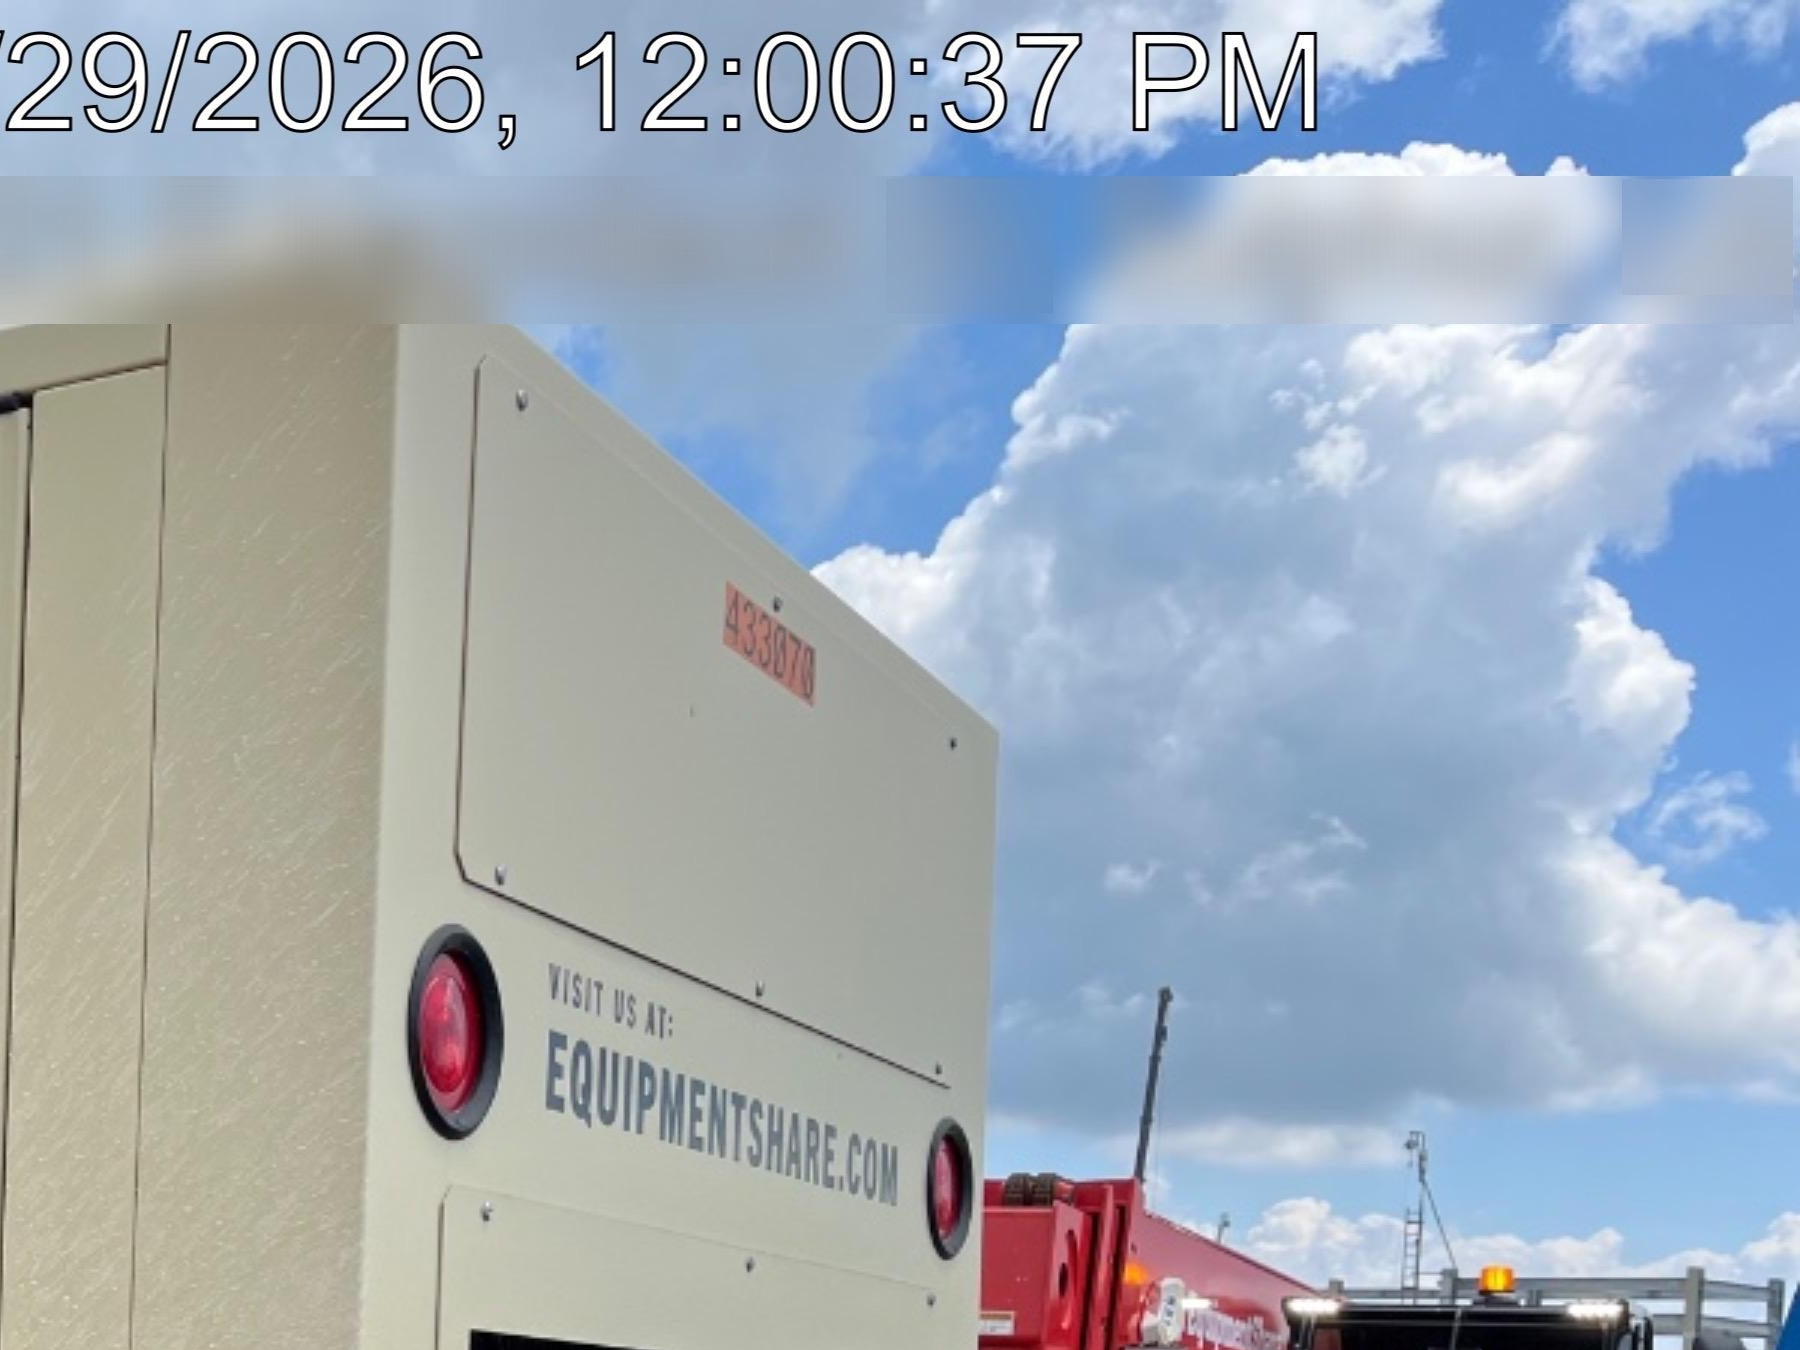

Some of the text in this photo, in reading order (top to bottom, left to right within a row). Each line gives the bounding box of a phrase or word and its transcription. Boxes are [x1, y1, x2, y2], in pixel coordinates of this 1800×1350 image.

[725, 589, 816, 701] 433070
[547, 961, 674, 1040] VISIT US AT:
[544, 1028, 899, 1207] EQUIPMENTSHARE.COM
